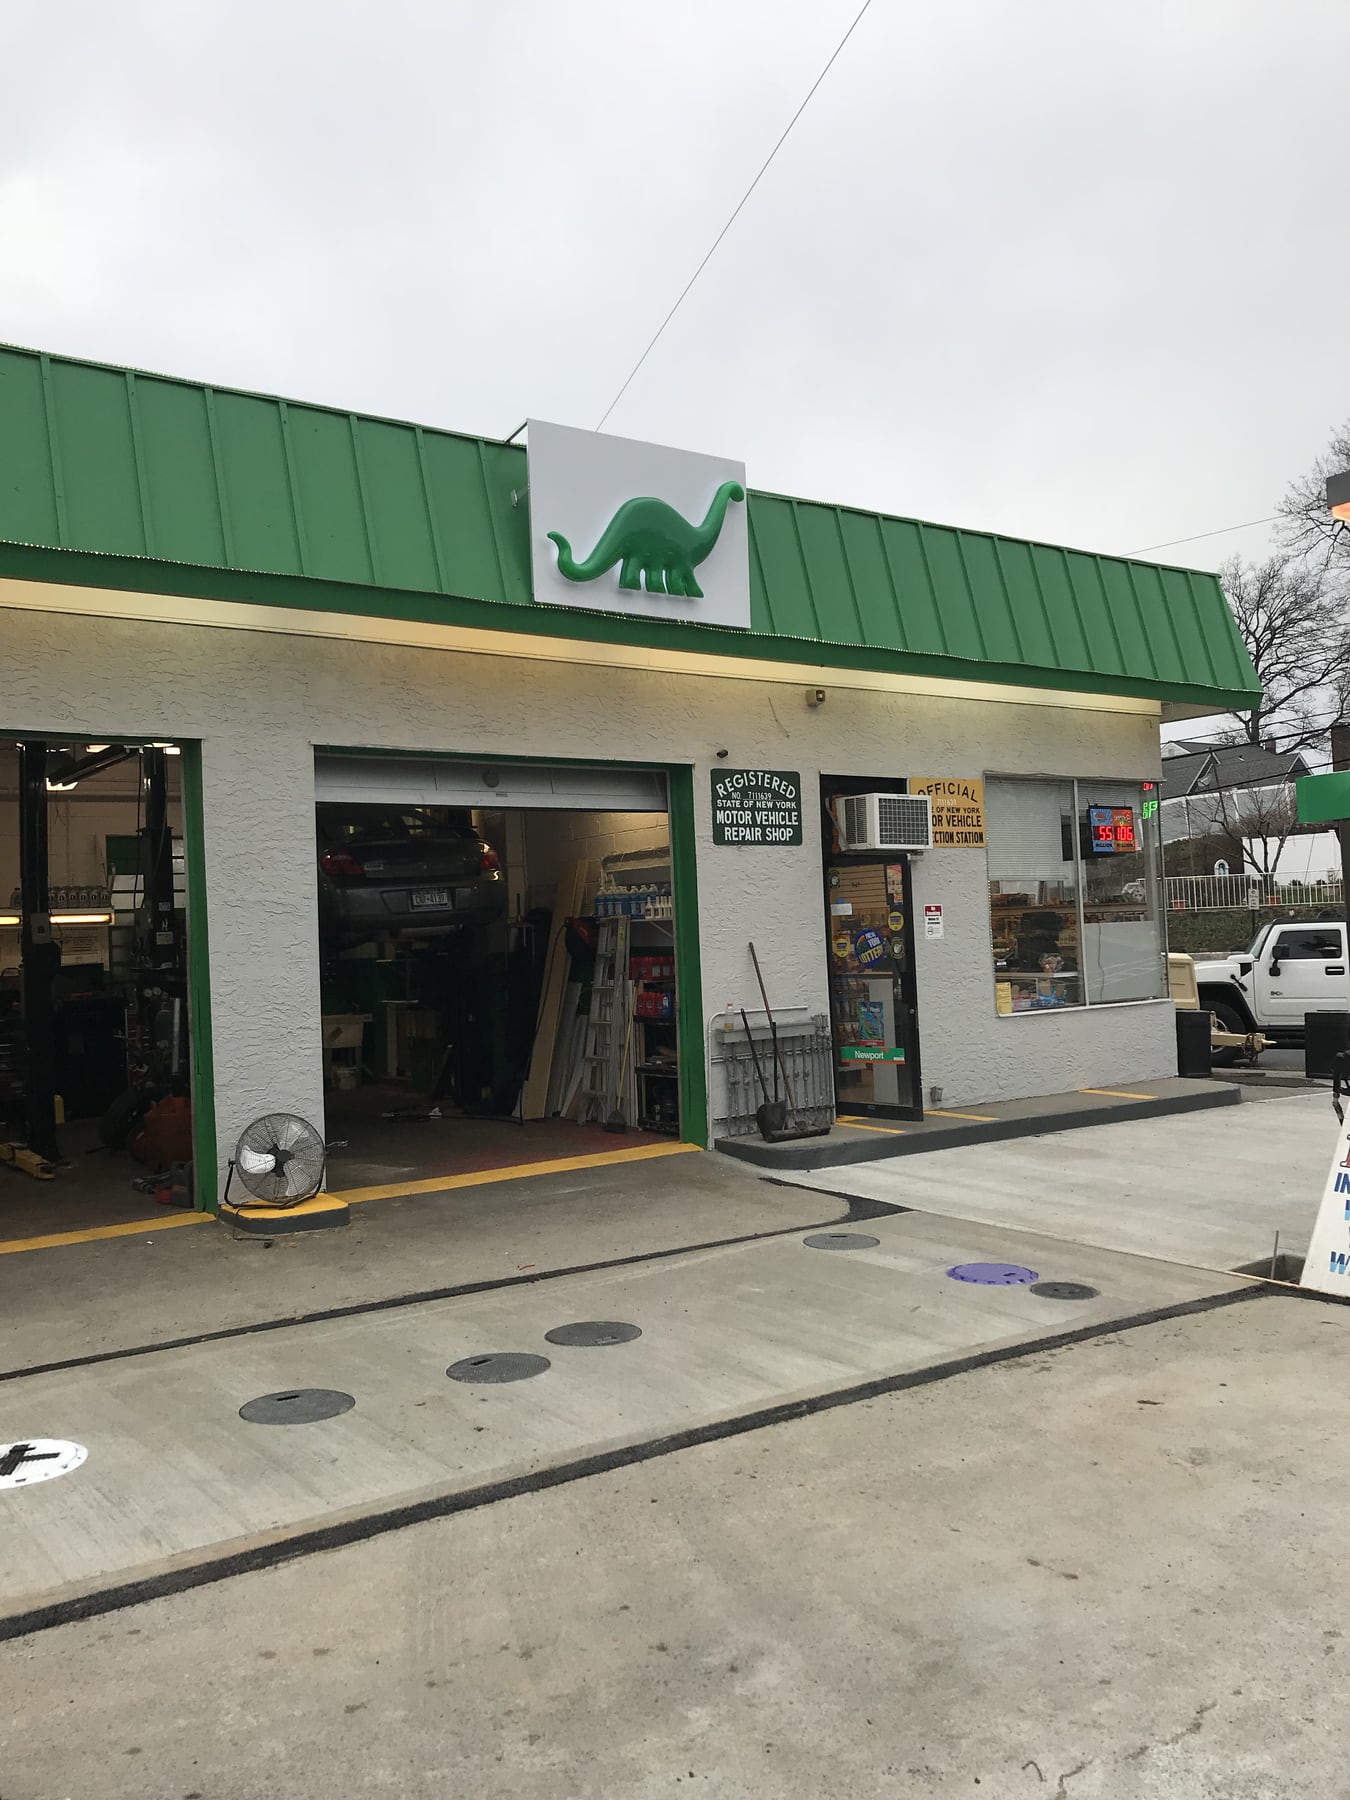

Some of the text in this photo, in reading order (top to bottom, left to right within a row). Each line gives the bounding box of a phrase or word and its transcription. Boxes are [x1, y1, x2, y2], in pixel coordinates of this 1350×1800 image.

[715, 771, 796, 799] REGISTERED
[731, 791, 772, 800] NO 7111639
[917, 782, 978, 803] OFFICIAL
[716, 799, 797, 809] STATE OF NEW YORK
[716, 809, 799, 825] MOTOR VEHICLE
[945, 815, 982, 827] VEHICLE
[724, 826, 794, 842] REPAIR SHOP
[955, 831, 984, 844] STATION
[1098, 826, 1113, 840] 55
[1116, 826, 1134, 841] 106
[854, 1050, 884, 1060] Newport
